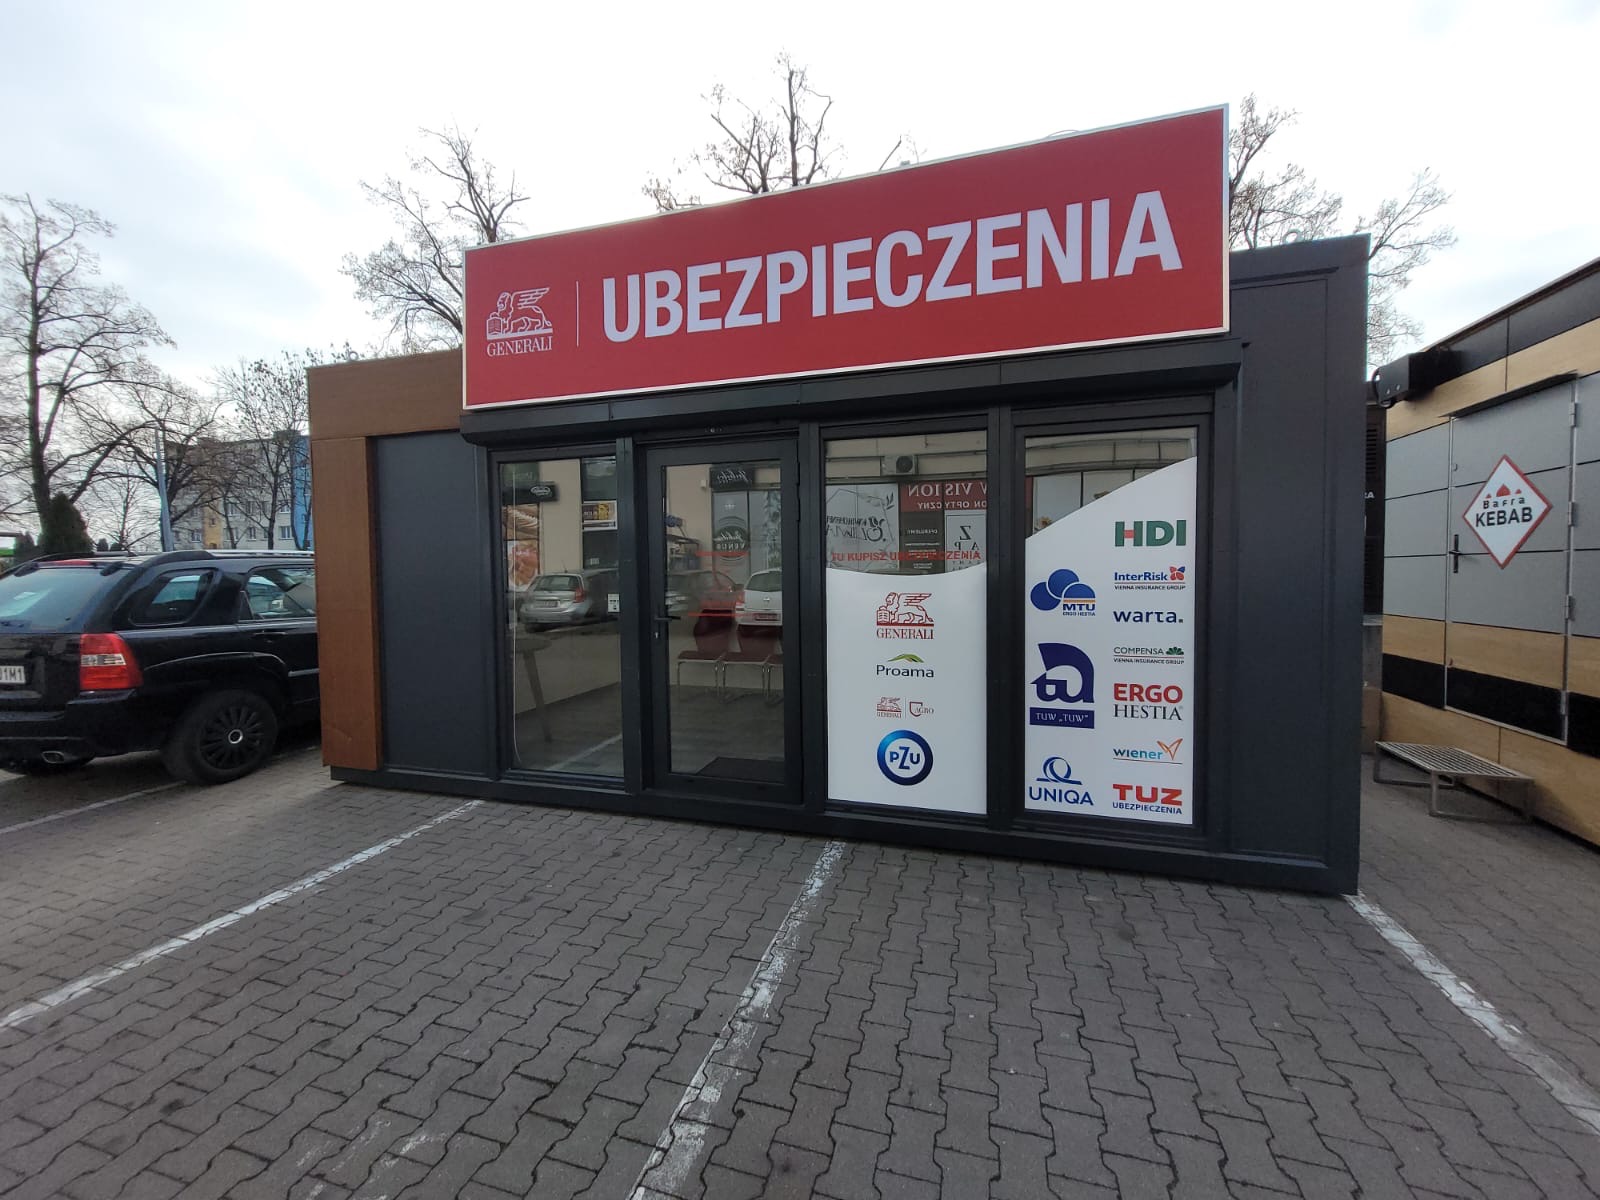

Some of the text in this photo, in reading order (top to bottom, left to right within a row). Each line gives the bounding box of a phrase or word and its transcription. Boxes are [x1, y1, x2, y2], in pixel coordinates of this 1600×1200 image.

[602, 190, 1183, 343] UBEZPIECZENIA
[486, 335, 553, 357] GENERALI
[1475, 506, 1533, 528] KEBAB
[1115, 519, 1187, 547] HDI
[847, 551, 888, 562] KUPISZ
[1114, 571, 1168, 581] InterRisk
[1063, 603, 1096, 611] MTU
[876, 627, 935, 640] GENERALI
[1113, 646, 1164, 656] COMPENSA
[876, 664, 934, 678] Proama
[1113, 682, 1183, 704] ERGO
[1035, 712, 1057, 721] TUW
[1113, 703, 1183, 721] HESTIA
[889, 745, 921, 770] PZU
[1113, 748, 1164, 760] wiener
[1028, 785, 1095, 806] UNIQA
[1112, 783, 1183, 806] TUZ
[1112, 801, 1183, 815] UBEZPIECZENIA
